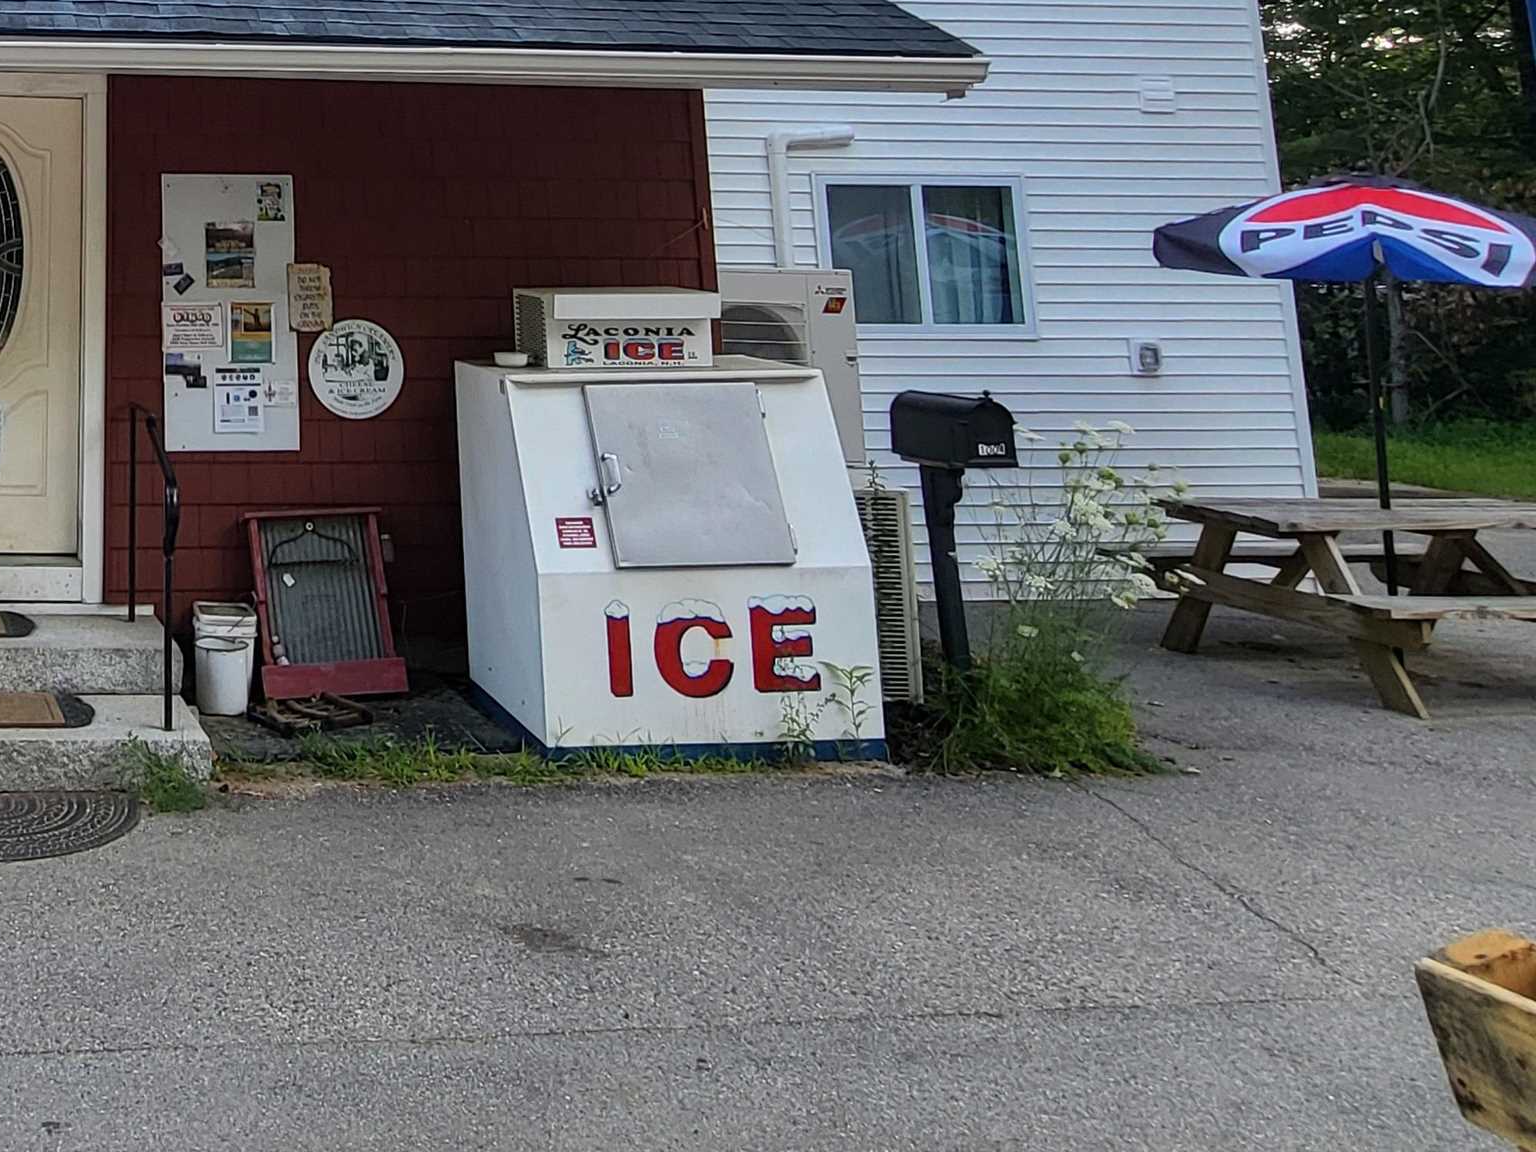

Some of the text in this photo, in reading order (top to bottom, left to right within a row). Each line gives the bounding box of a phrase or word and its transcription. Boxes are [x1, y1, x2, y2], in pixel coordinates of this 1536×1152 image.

[1240, 209, 1514, 279] PEPSI
[562, 323, 695, 346] LACONIA
[602, 337, 685, 360] ICE
[603, 594, 822, 698] ICE
